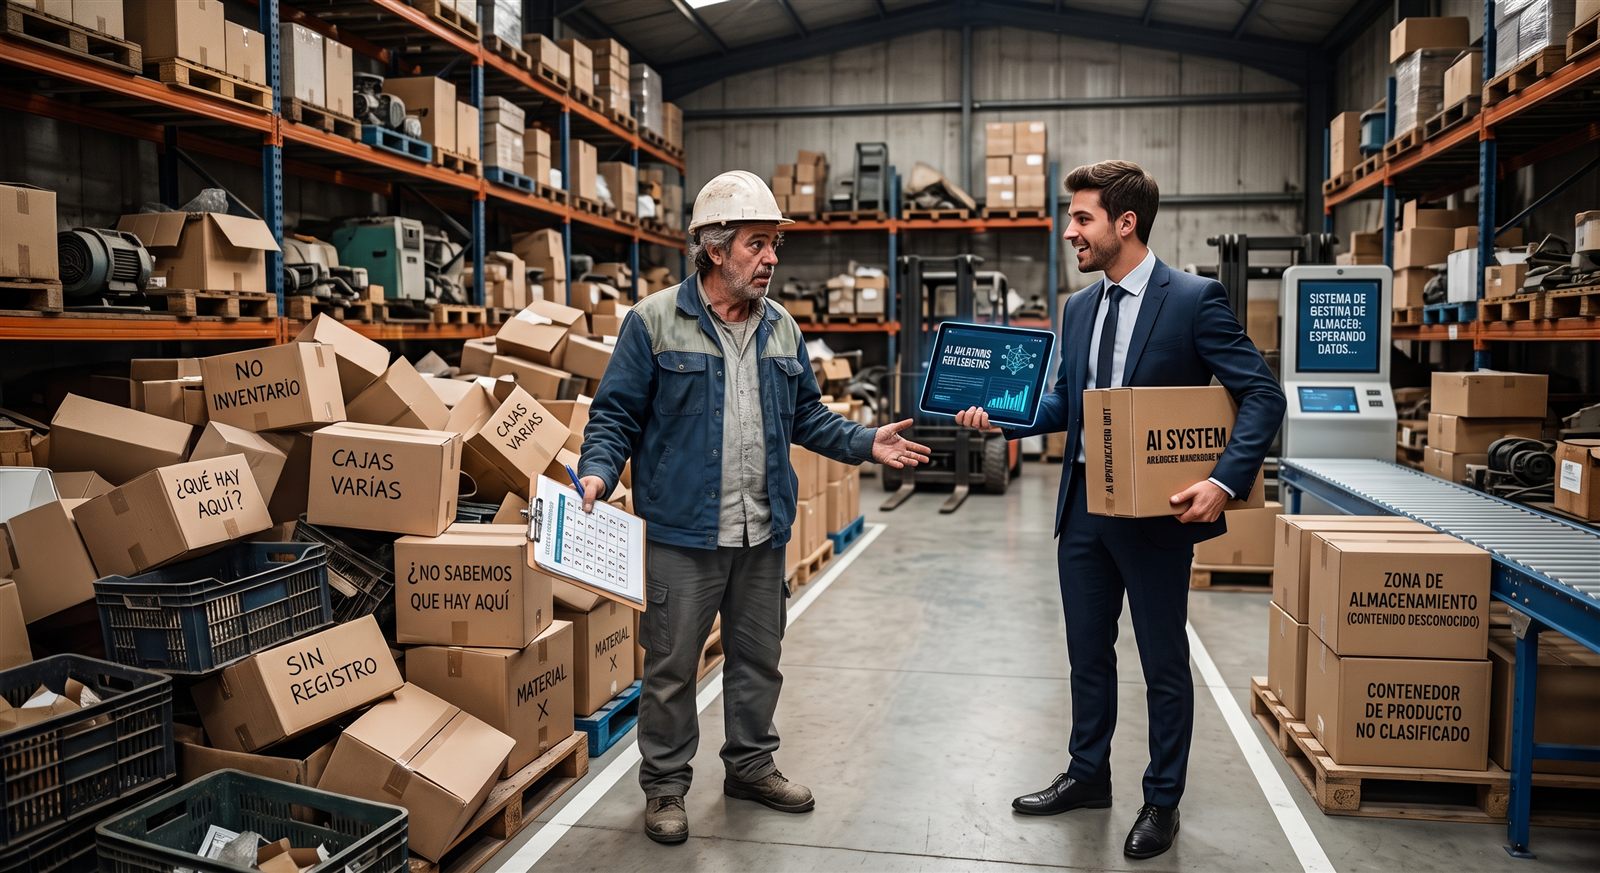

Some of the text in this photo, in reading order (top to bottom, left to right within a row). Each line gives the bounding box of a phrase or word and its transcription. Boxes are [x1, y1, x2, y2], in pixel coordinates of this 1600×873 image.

[1310, 293, 1366, 304] SISTEMA DE
[1353, 306, 1366, 316] DE
[1310, 331, 1366, 342] ESPERANDO
[1318, 344, 1357, 354] DATOS...
[235, 360, 263, 380] NO
[496, 403, 527, 437] CAJAS
[506, 412, 543, 450] VARIAS
[1146, 427, 1226, 451] AI SYSTEM
[332, 449, 394, 471] CAJAS
[176, 468, 239, 499] ¿QUÉ HAY
[331, 475, 402, 500] VARÍAS
[199, 490, 243, 518] AQUÍ?
[408, 562, 512, 584] ¿NO SABEMOS
[1384, 572, 1443, 589] ZONA DE
[411, 589, 509, 612] QUE HAY AQUÍ
[1349, 592, 1477, 610] ALMACENAMIENTO
[1347, 612, 1480, 629] (CONTENIDO DESCONOCIDO)
[595, 626, 630, 658] MATERIAL
[287, 647, 324, 675] SIN
[610, 654, 617, 672] X
[290, 658, 377, 704] REGISTRO
[517, 664, 567, 707] MATERIAL
[1368, 682, 1460, 701] CONTENEDOR
[537, 698, 548, 722] X
[1366, 703, 1462, 721] DE PRODUCTO
[1356, 722, 1470, 742] NO CLASIFICADO
